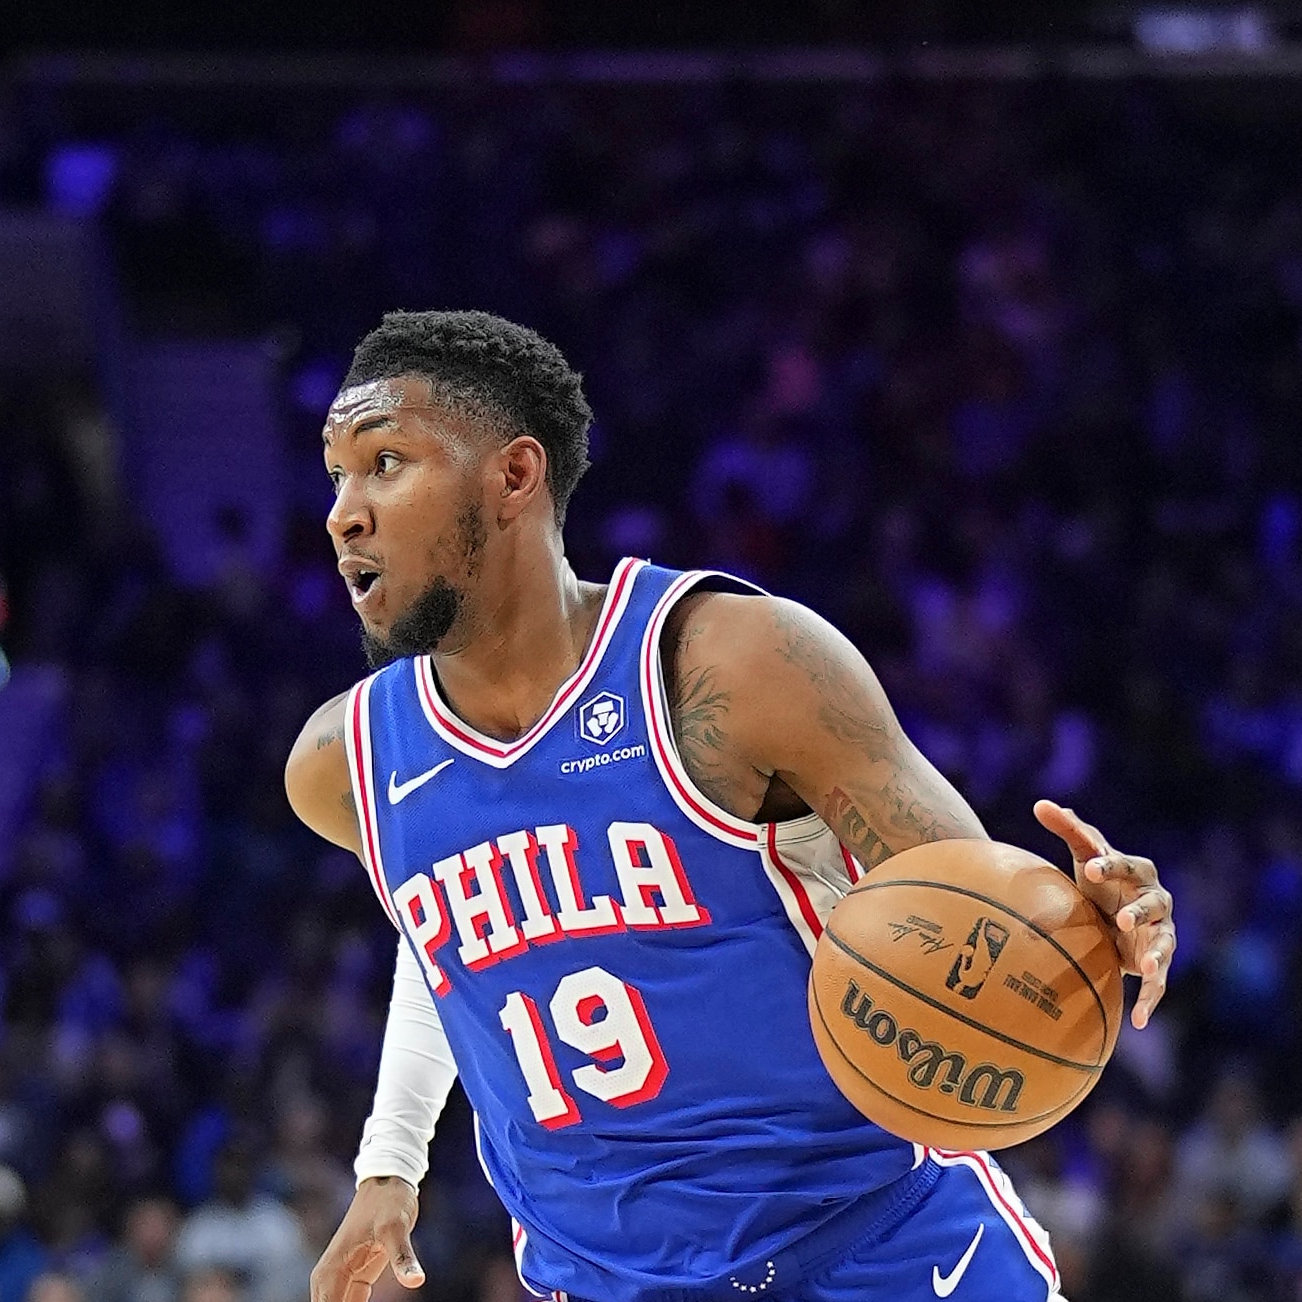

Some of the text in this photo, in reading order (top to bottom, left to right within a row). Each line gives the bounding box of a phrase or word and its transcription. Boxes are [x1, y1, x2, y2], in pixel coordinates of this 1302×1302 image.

[559, 743, 646, 775] crypto.com
[392, 821, 712, 998] PHILA
[498, 965, 670, 1131] 19
[840, 977, 1027, 1114] Wilson
